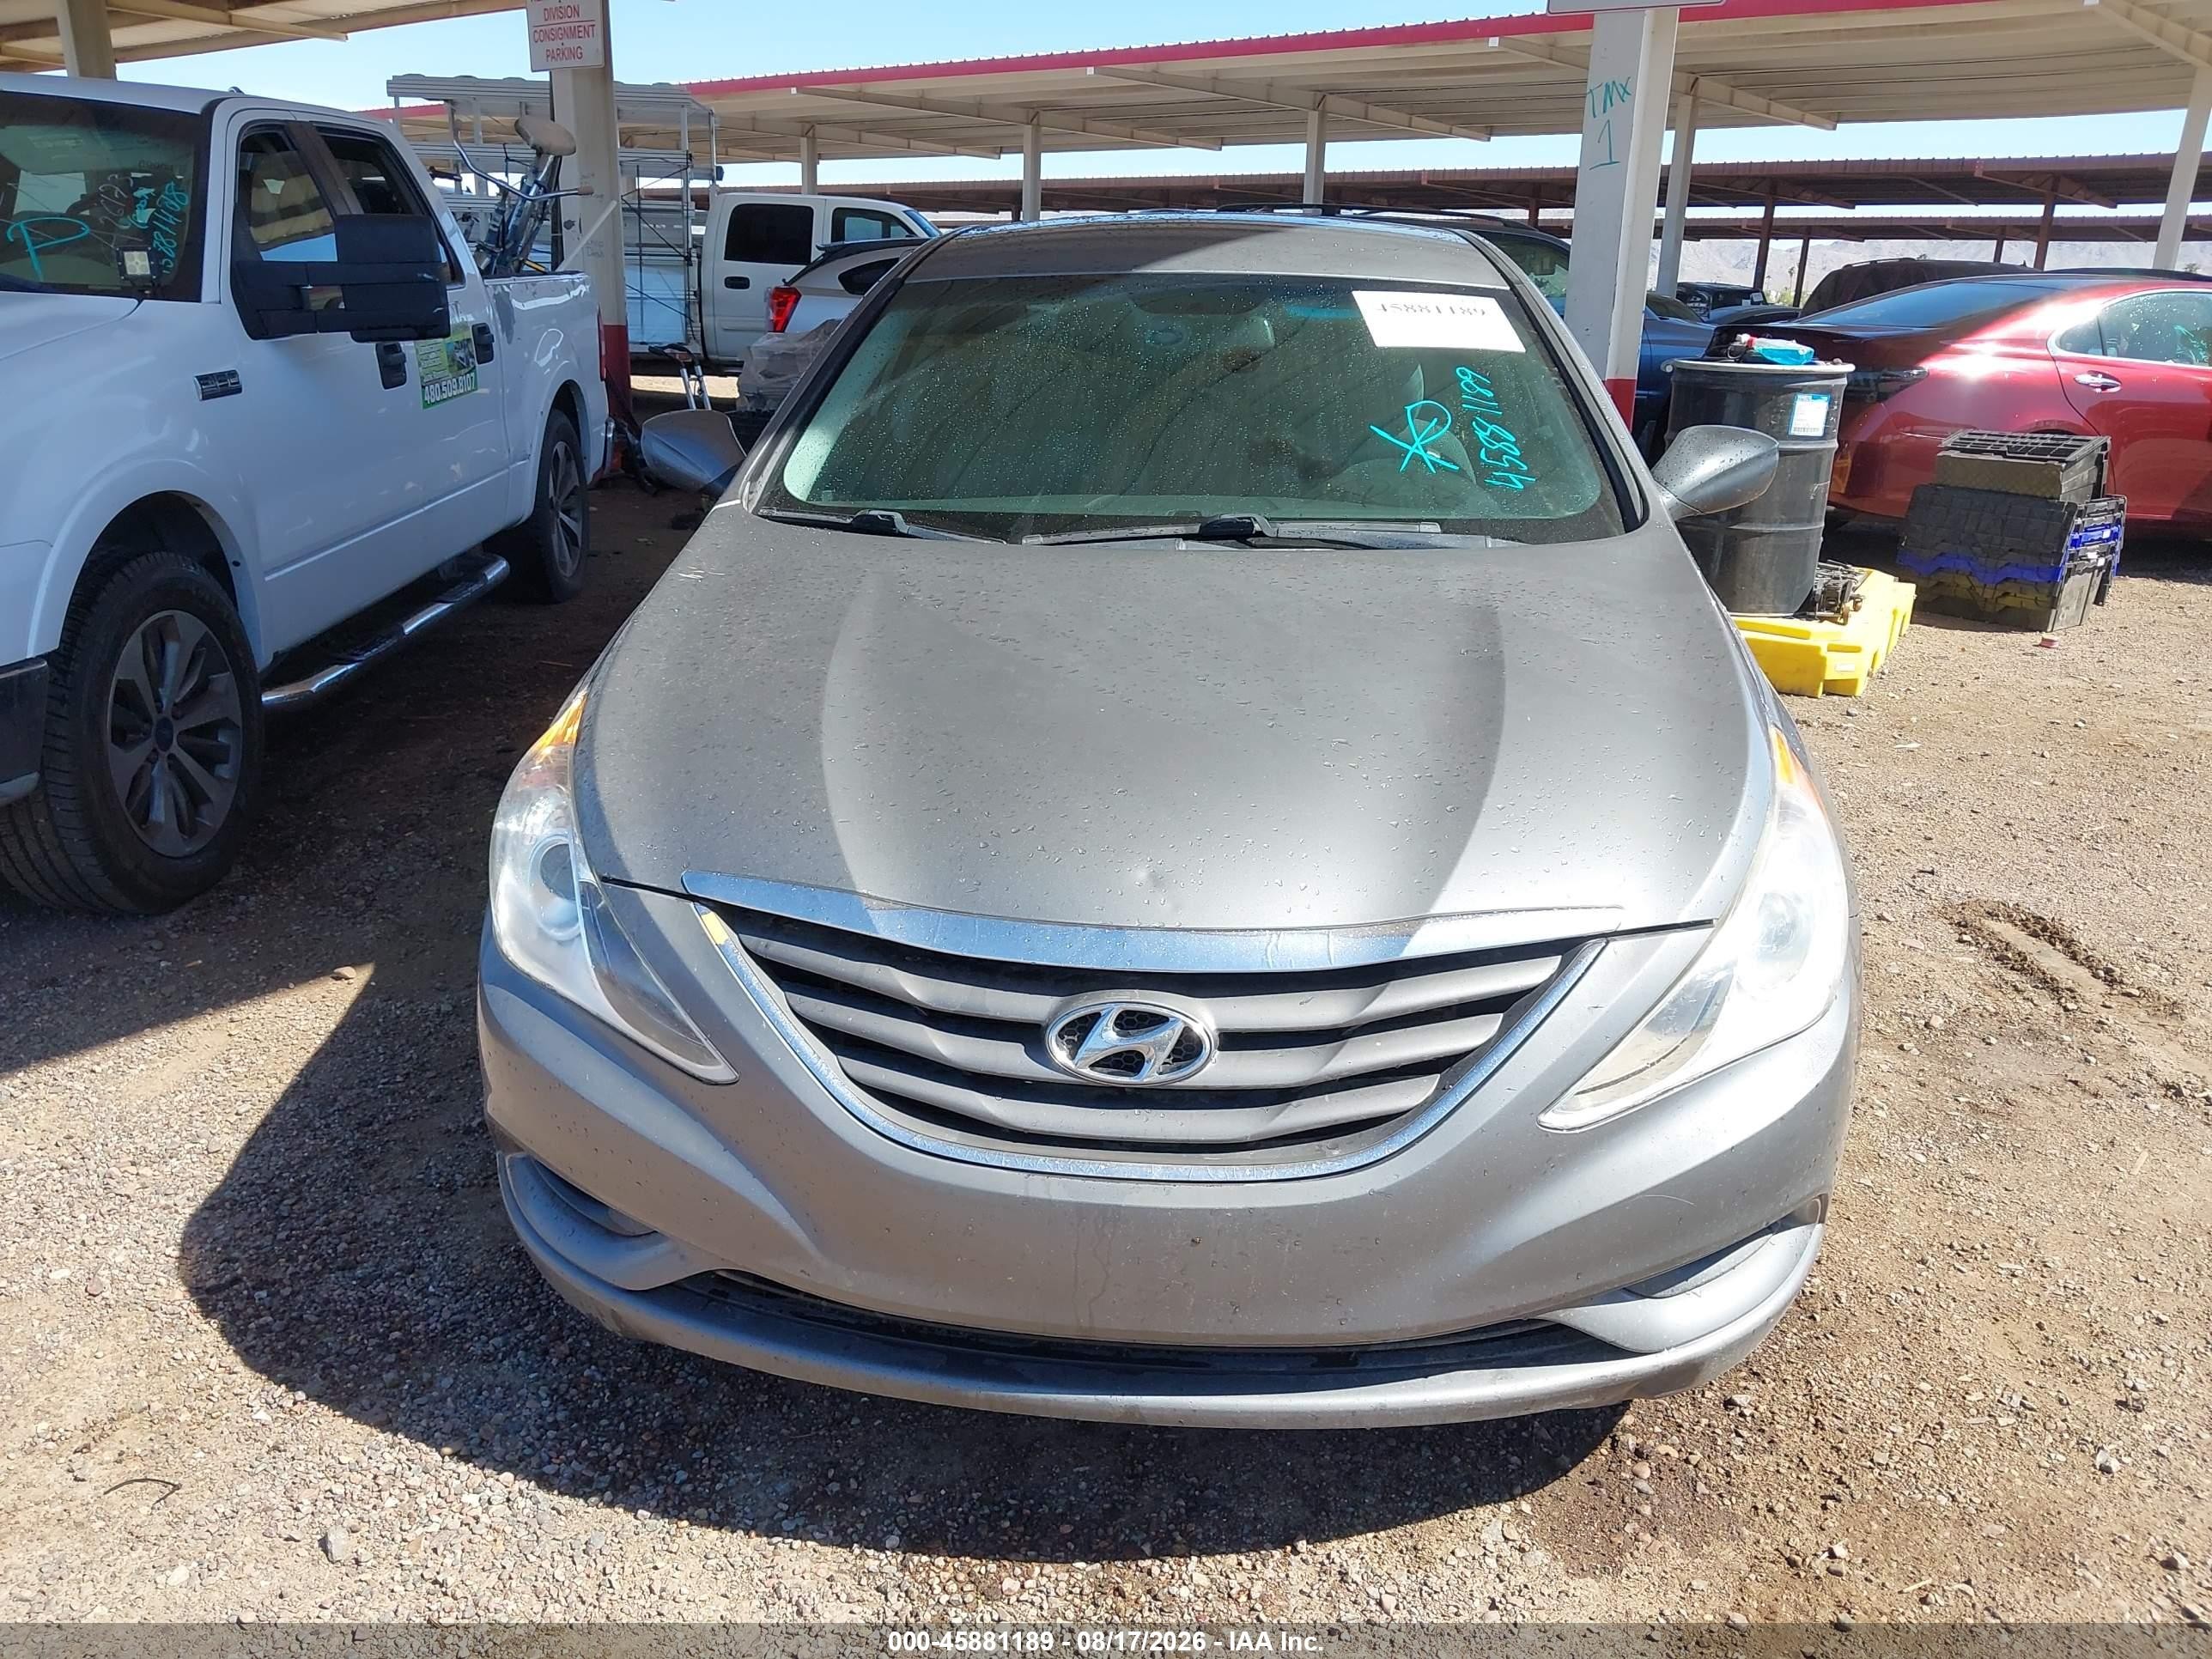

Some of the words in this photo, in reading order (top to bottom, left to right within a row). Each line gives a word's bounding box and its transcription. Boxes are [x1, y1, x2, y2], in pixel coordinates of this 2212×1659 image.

[544, 4, 580, 21] DIVISION
[532, 24, 596, 43] CONSIGNMENT
[545, 46, 583, 63] PARKING
[1589, 119, 1621, 171] 1
[424, 372, 476, 404] 480.509.8107
